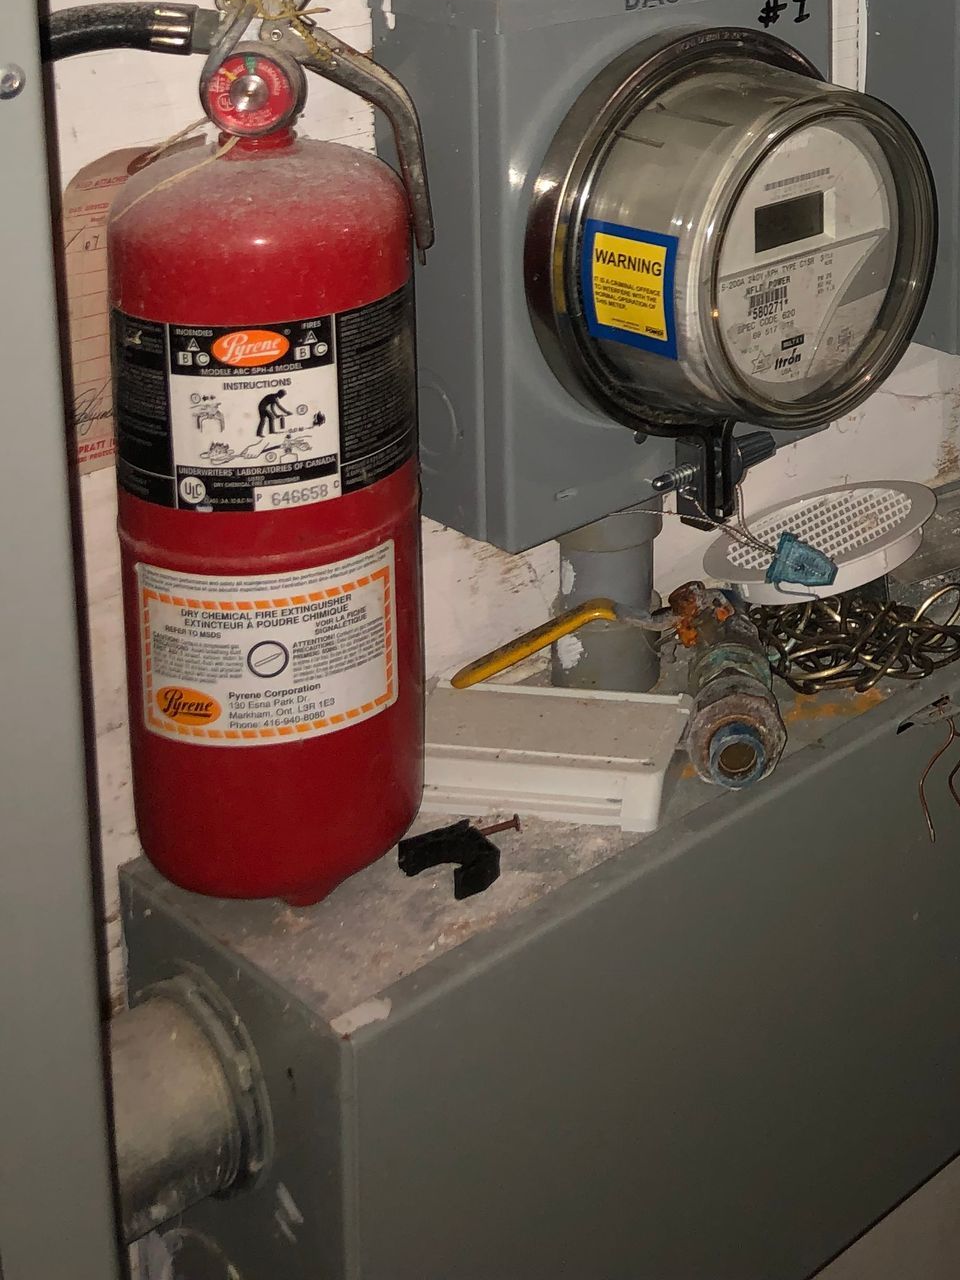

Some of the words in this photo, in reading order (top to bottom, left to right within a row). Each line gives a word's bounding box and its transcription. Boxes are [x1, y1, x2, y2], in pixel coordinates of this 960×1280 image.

[595, 248, 662, 277] WARNING
[782, 262, 796, 272] TYPE
[768, 275, 791, 289] POWER
[176, 328, 213, 337] INCENDIES
[303, 320, 322, 329] FIRES
[736, 321, 756, 335] SPEC
[759, 313, 777, 327] CODE
[222, 333, 282, 363] Pyrene
[774, 348, 802, 370] Itron
[233, 366, 250, 375] ABC
[275, 363, 303, 372] MODEL
[223, 377, 292, 391] INSTRUCTIONS
[79, 439, 106, 454] PRATT
[237, 464, 293, 476] LABORATORIES
[294, 461, 305, 470] OF
[305, 456, 337, 468] CANADA
[184, 481, 203, 501] ULC
[256, 493, 263, 501] P
[271, 484, 329, 506] 646658
[333, 480, 340, 488] C
[181, 608, 199, 618] DRY
[201, 611, 252, 621] CHEMICAL
[255, 609, 278, 620] FIRE
[281, 593, 352, 616] EXTINGUISHER
[184, 619, 244, 630] EXTINCTEUR
[256, 618, 300, 629] POUDRE
[302, 604, 350, 623] CHIMIQUE
[315, 618, 334, 627] VOIR
[335, 613, 346, 622] LA
[346, 606, 367, 618] FICHE
[165, 625, 187, 635] REFER
[189, 628, 198, 638] TO
[200, 630, 222, 639] MSDS
[228, 691, 262, 700] Pyrene
[264, 683, 321, 699] Corporation
[163, 688, 214, 717] Pyrene
[229, 702, 245, 710] 130
[248, 701, 271, 709] Esna
[273, 698, 295, 708] Park
[297, 702, 316, 713] L3R
[318, 697, 336, 708] 1E3
[263, 710, 326, 728] 416-940-8080
